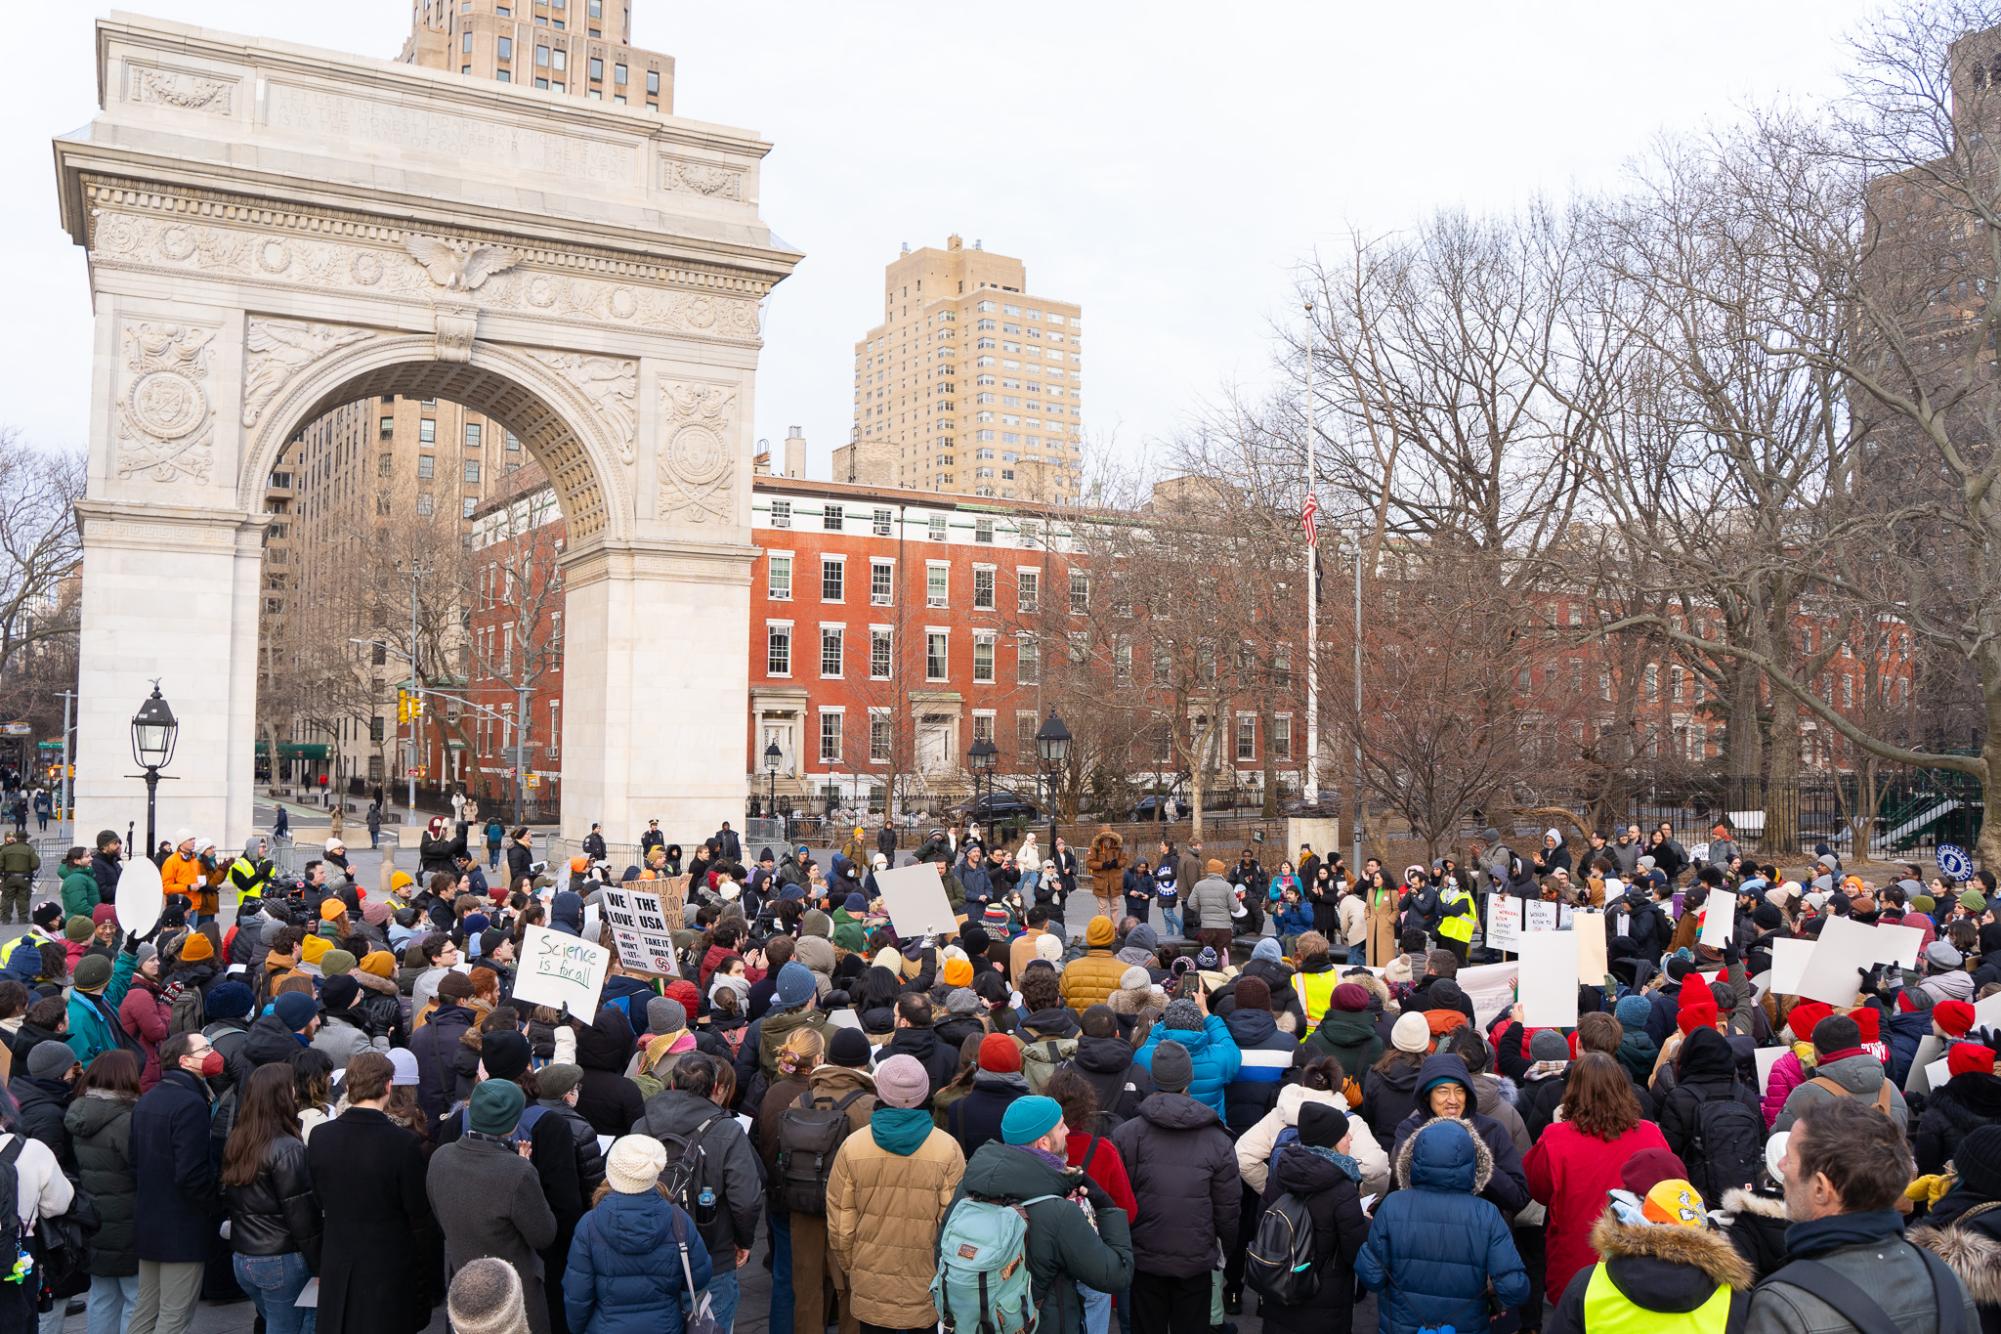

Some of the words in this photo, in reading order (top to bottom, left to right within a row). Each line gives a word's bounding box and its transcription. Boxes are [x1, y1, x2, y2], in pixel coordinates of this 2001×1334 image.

[280, 104, 311, 116] AND
[318, 107, 348, 123] THE
[359, 111, 418, 136] HONEST
[607, 892, 626, 908] WE
[635, 897, 658, 912] THE
[609, 911, 635, 927] LOVE
[639, 915, 664, 930] USA
[644, 937, 661, 946] TAKE
[662, 940, 669, 948] IT
[538, 935, 597, 966] Science
[649, 947, 669, 958] AWAY
[622, 958, 648, 969] FASCISTS
[539, 957, 550, 972] is
[559, 960, 574, 976] for
[575, 967, 591, 986] all
